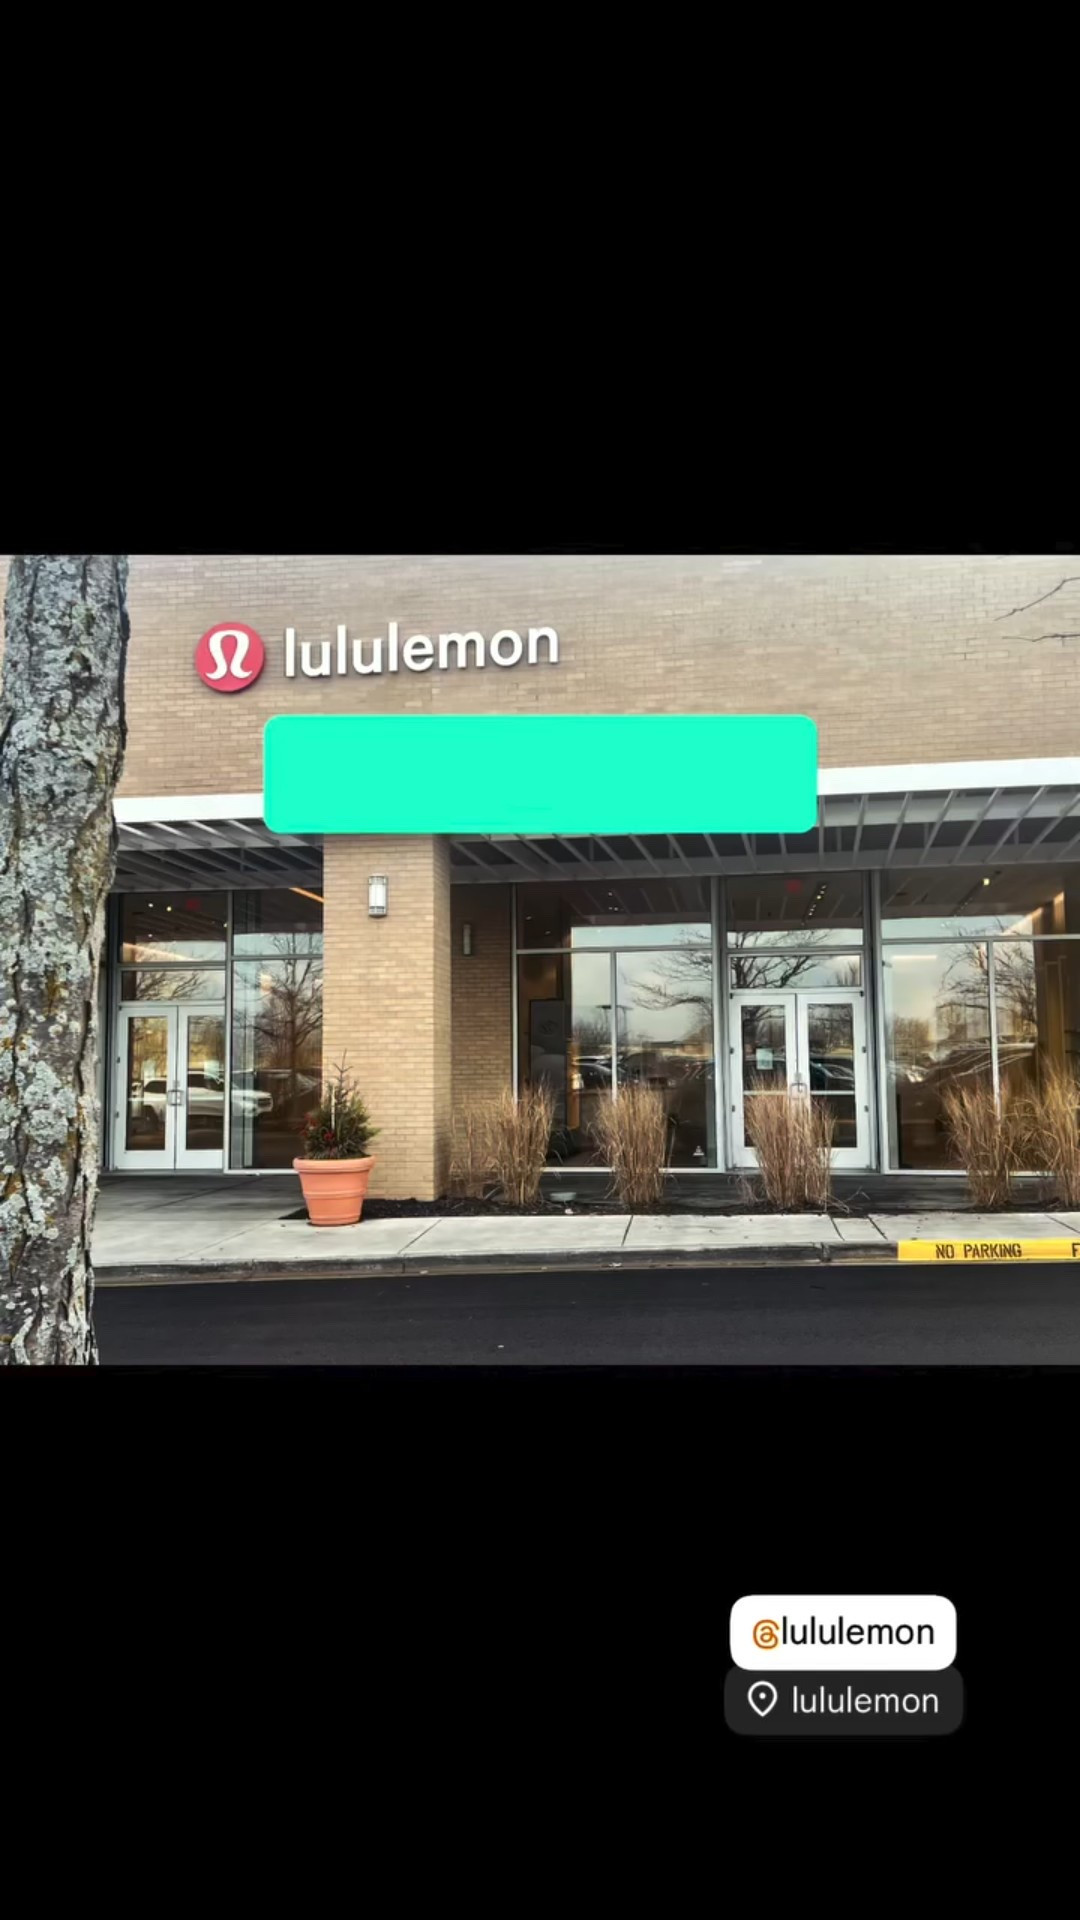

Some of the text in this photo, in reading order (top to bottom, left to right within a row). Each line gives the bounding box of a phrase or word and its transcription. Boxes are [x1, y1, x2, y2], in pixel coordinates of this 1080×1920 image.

[284, 621, 560, 678] lululemon
[935, 1244, 955, 1259] NO
[963, 1243, 1022, 1258] PARKING
